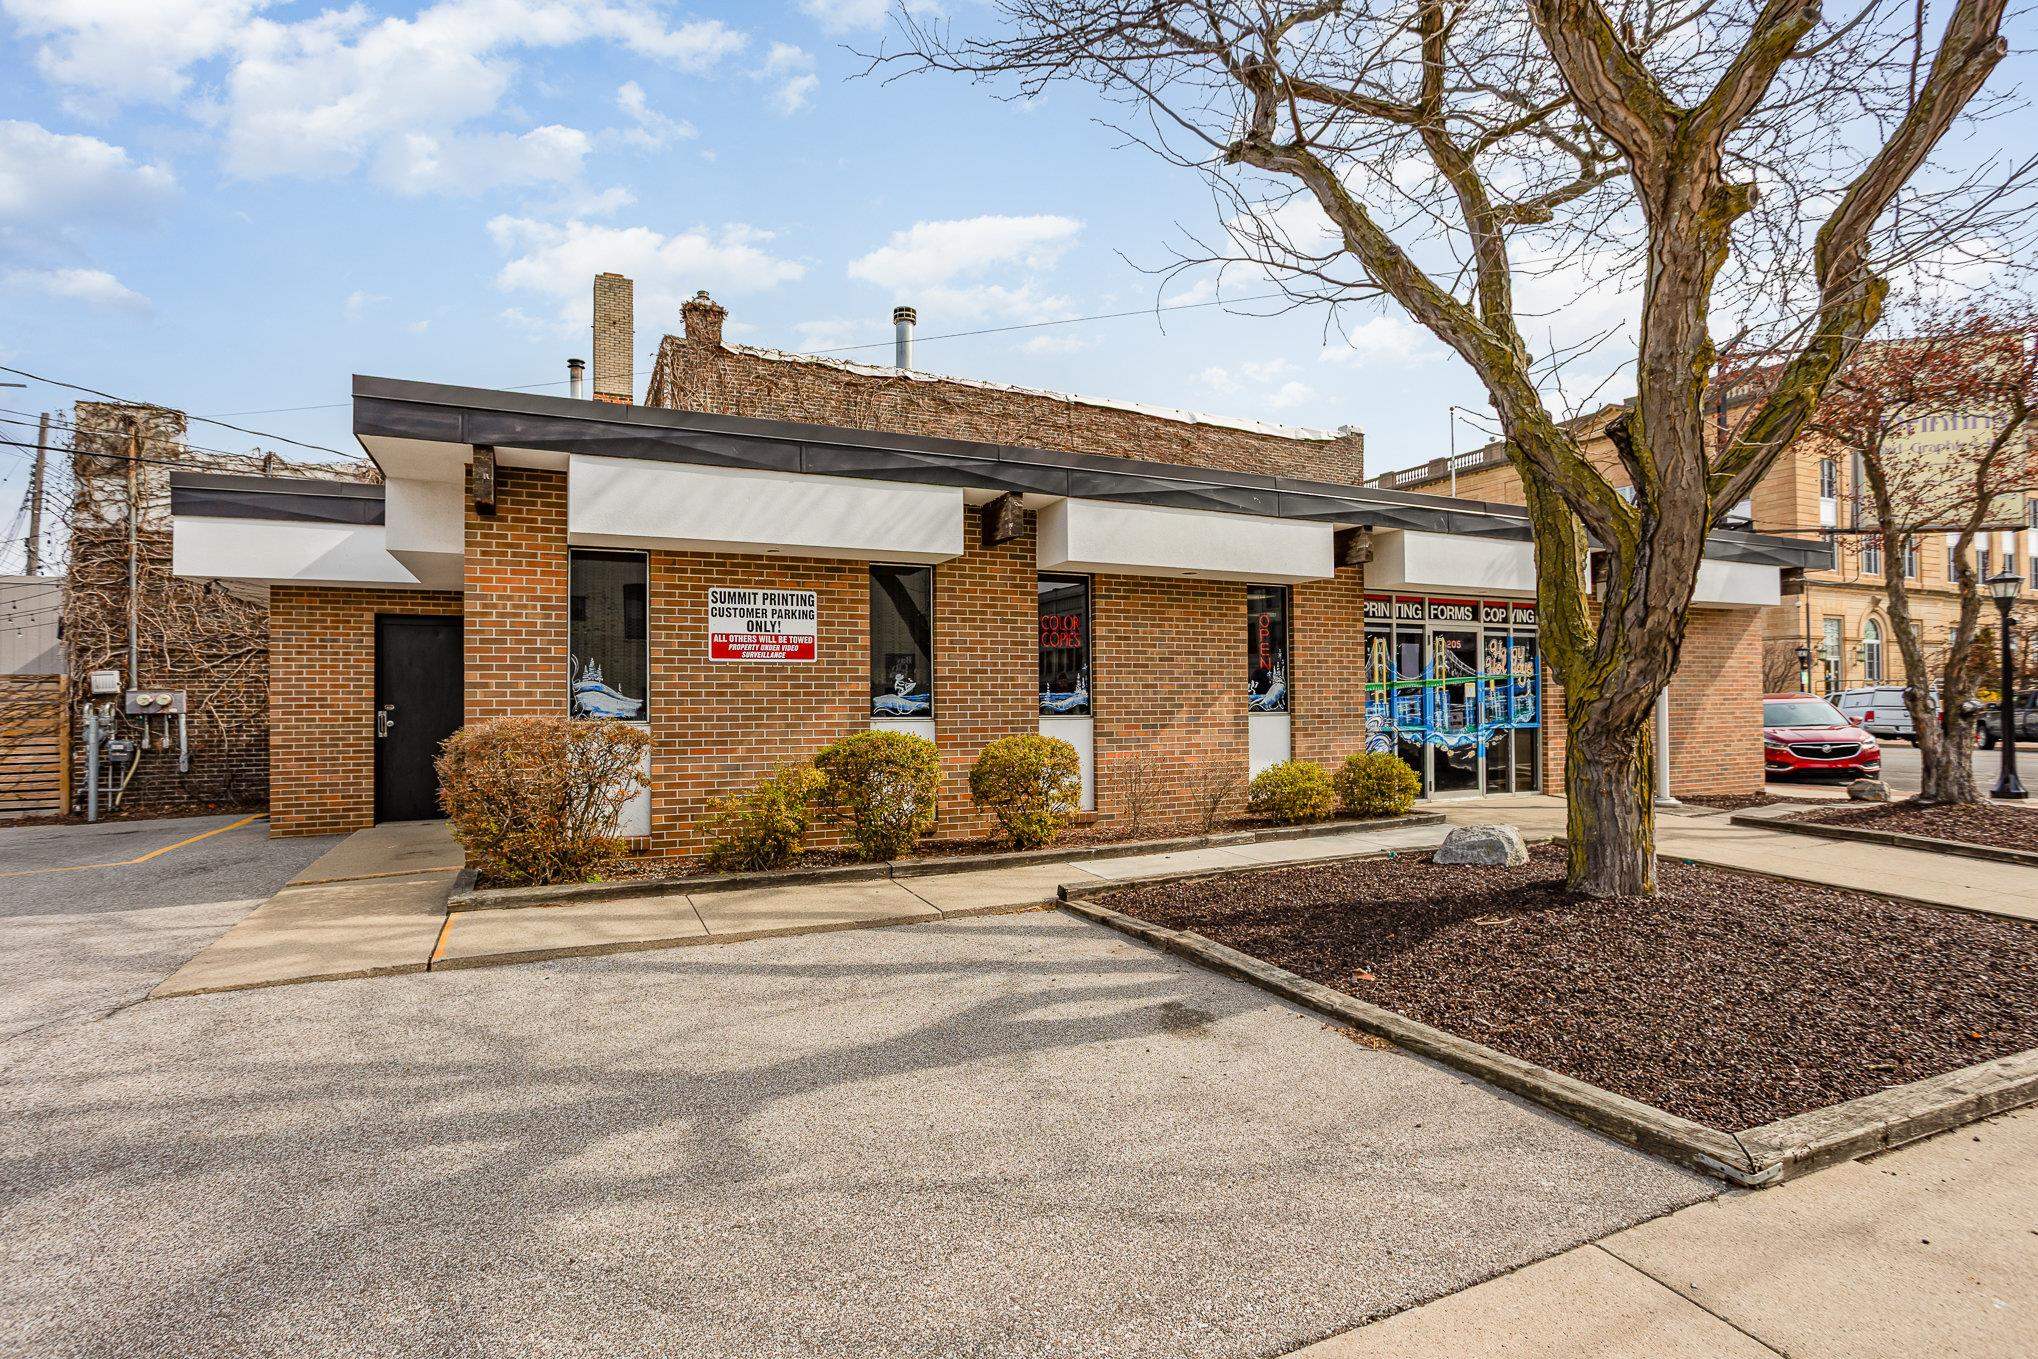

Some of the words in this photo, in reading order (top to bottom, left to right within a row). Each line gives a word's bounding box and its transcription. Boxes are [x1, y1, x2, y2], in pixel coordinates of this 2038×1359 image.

[711, 590, 759, 606] SUMMIT
[762, 592, 815, 607] PRINTING
[711, 606, 768, 619] CUSTOMER
[771, 608, 815, 621] PARKING
[1430, 605, 1473, 620] FORMS
[1482, 607, 1535, 623] COPYING
[746, 619, 781, 633] ONLY!
[1041, 614, 1080, 631] COLOR
[713, 634, 728, 643] ALL
[729, 635, 757, 643] OTHERS
[758, 635, 777, 644] WILL
[778, 636, 788, 644] BE
[787, 636, 813, 644] TOWED
[1041, 632, 1081, 648] COPIES
[1259, 614, 1271, 670] OPEN
[728, 643, 760, 651] PROPERTY
[760, 644, 781, 652] UNDER
[781, 644, 799, 652] VIDEO
[741, 651, 787, 659] SURVEILLANCE
